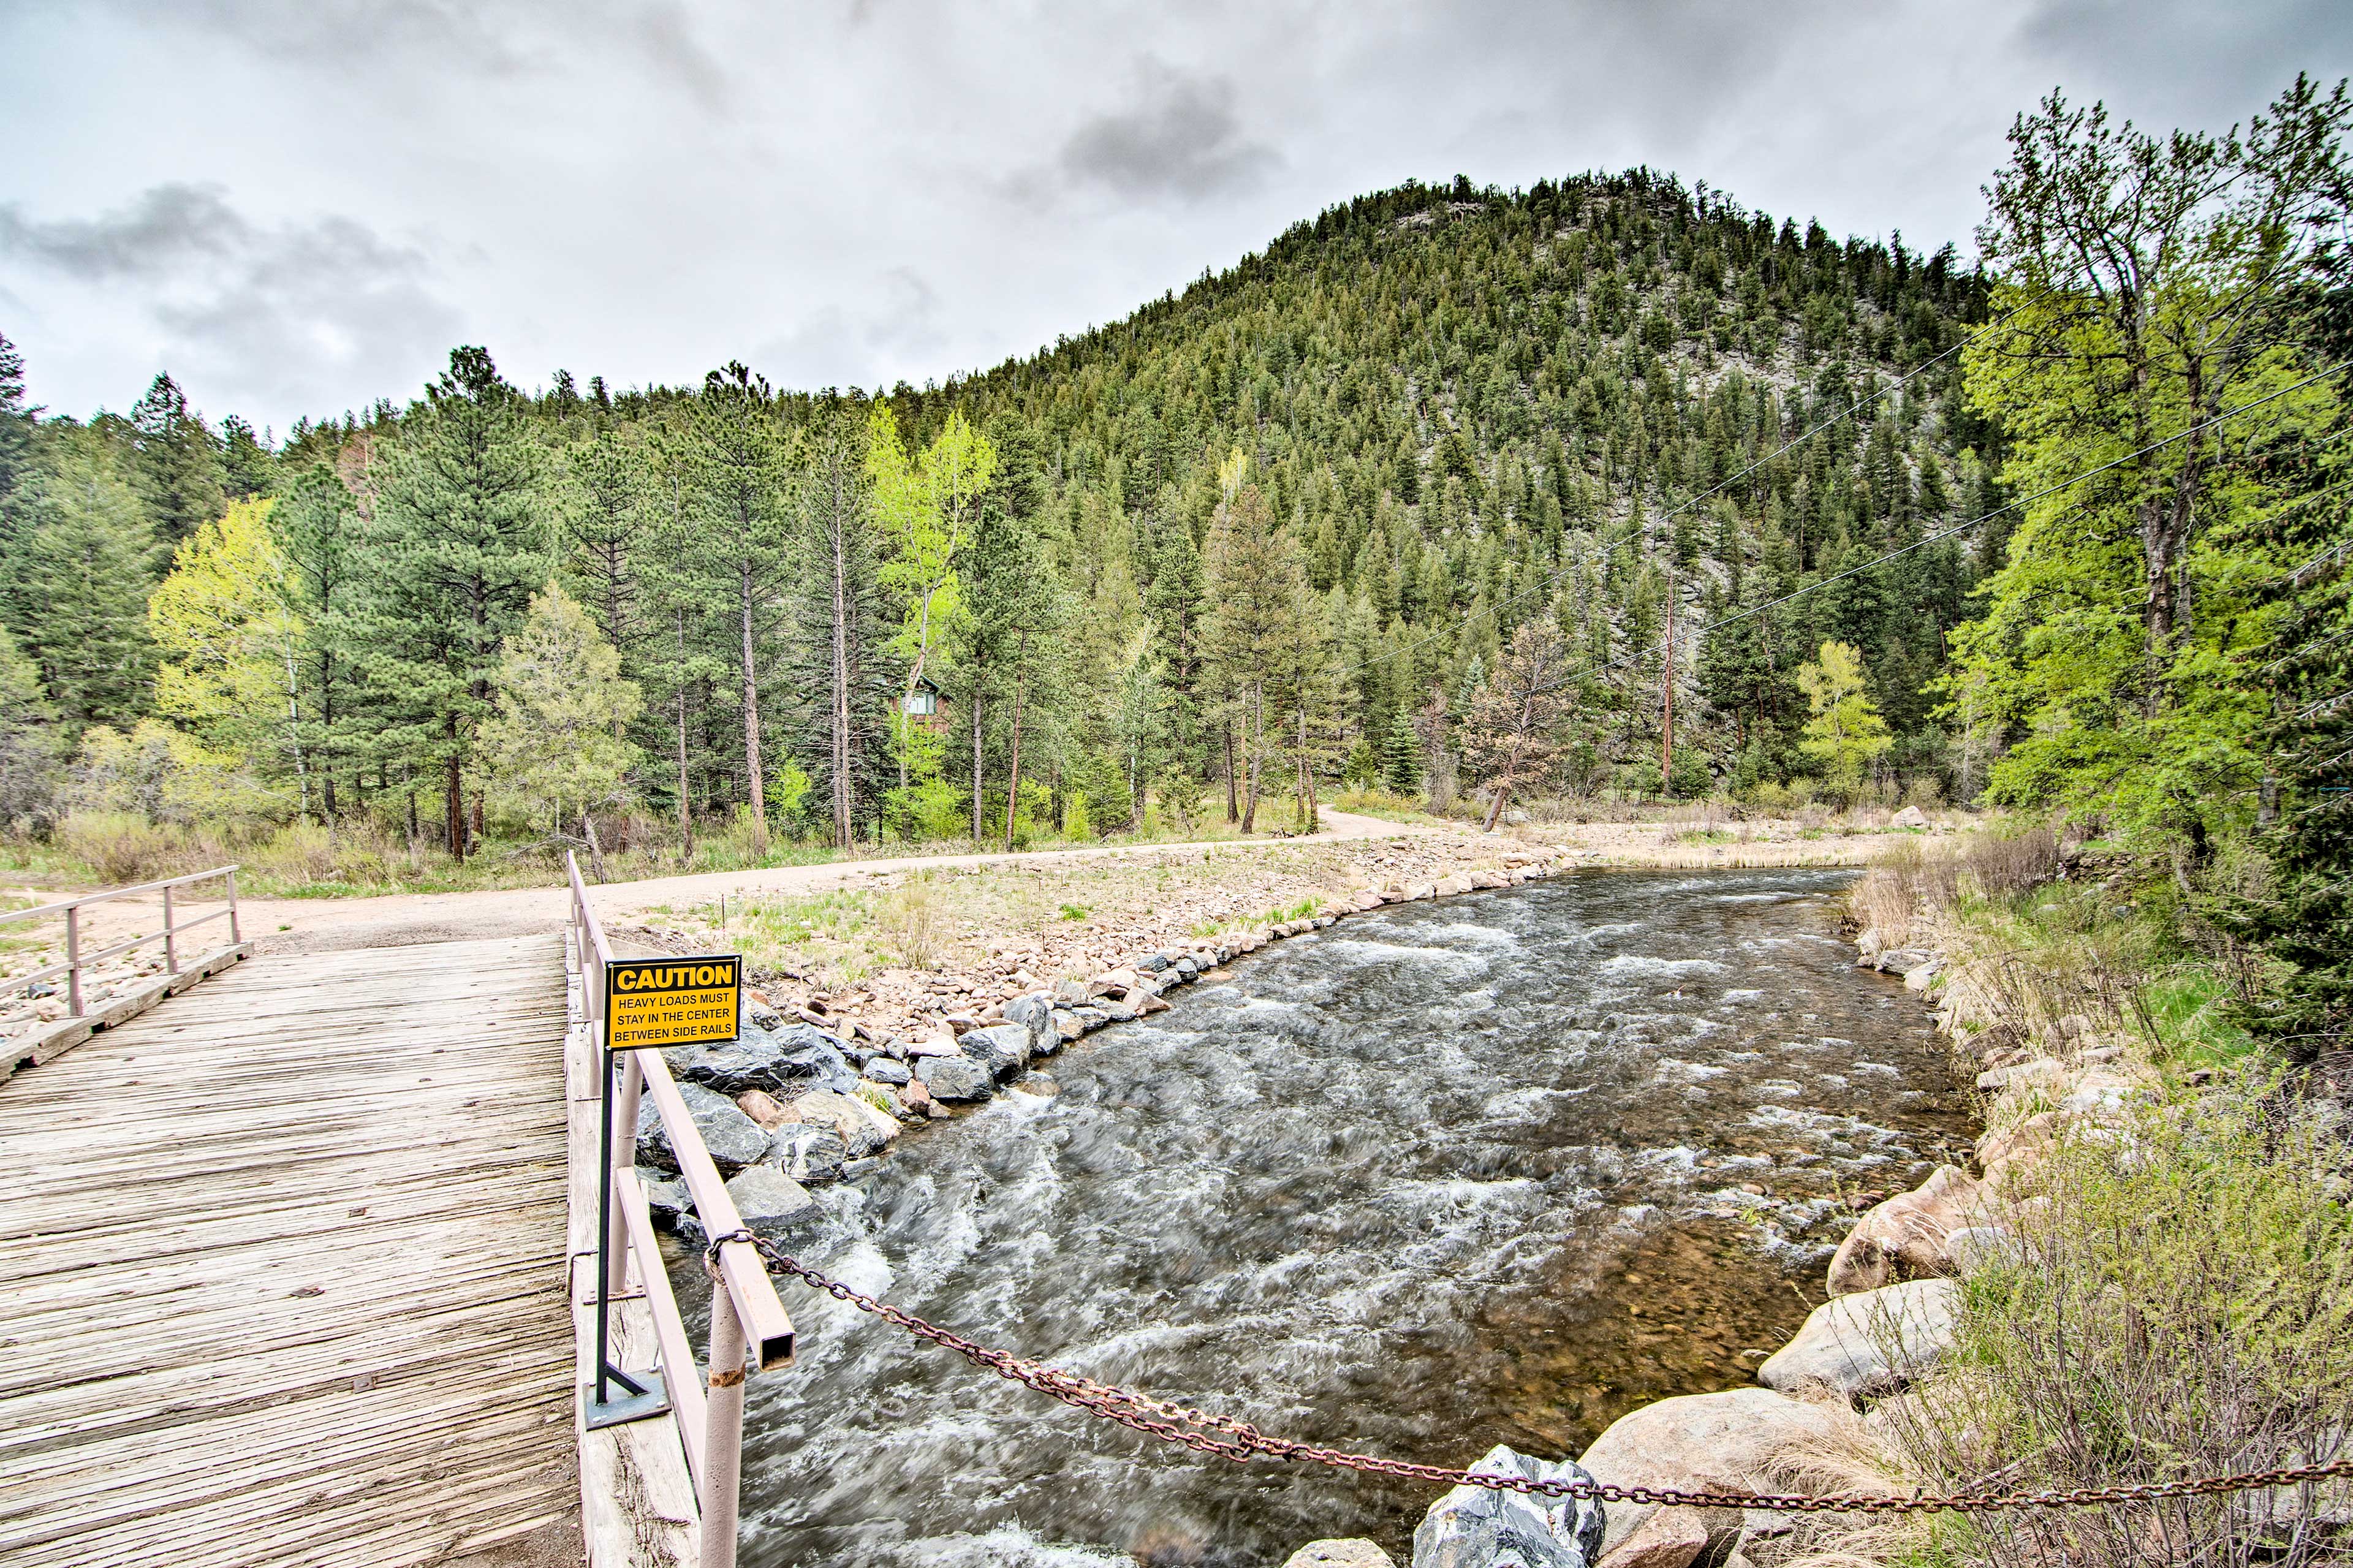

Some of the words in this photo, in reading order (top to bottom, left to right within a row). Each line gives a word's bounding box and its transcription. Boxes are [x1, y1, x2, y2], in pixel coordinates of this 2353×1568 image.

[617, 965, 732, 990] CAUTION
[620, 998, 656, 1009] HEAVY
[660, 995, 696, 1006] LOADS
[700, 993, 729, 1003] MUST
[618, 1015, 645, 1025] STAY
[648, 1013, 658, 1023] IN
[662, 1012, 683, 1021] THE
[687, 1009, 729, 1020] CENTER
[615, 1029, 669, 1041] BETWEEN
[673, 1026, 697, 1037] SIDE
[701, 1024, 731, 1034] RAILS
